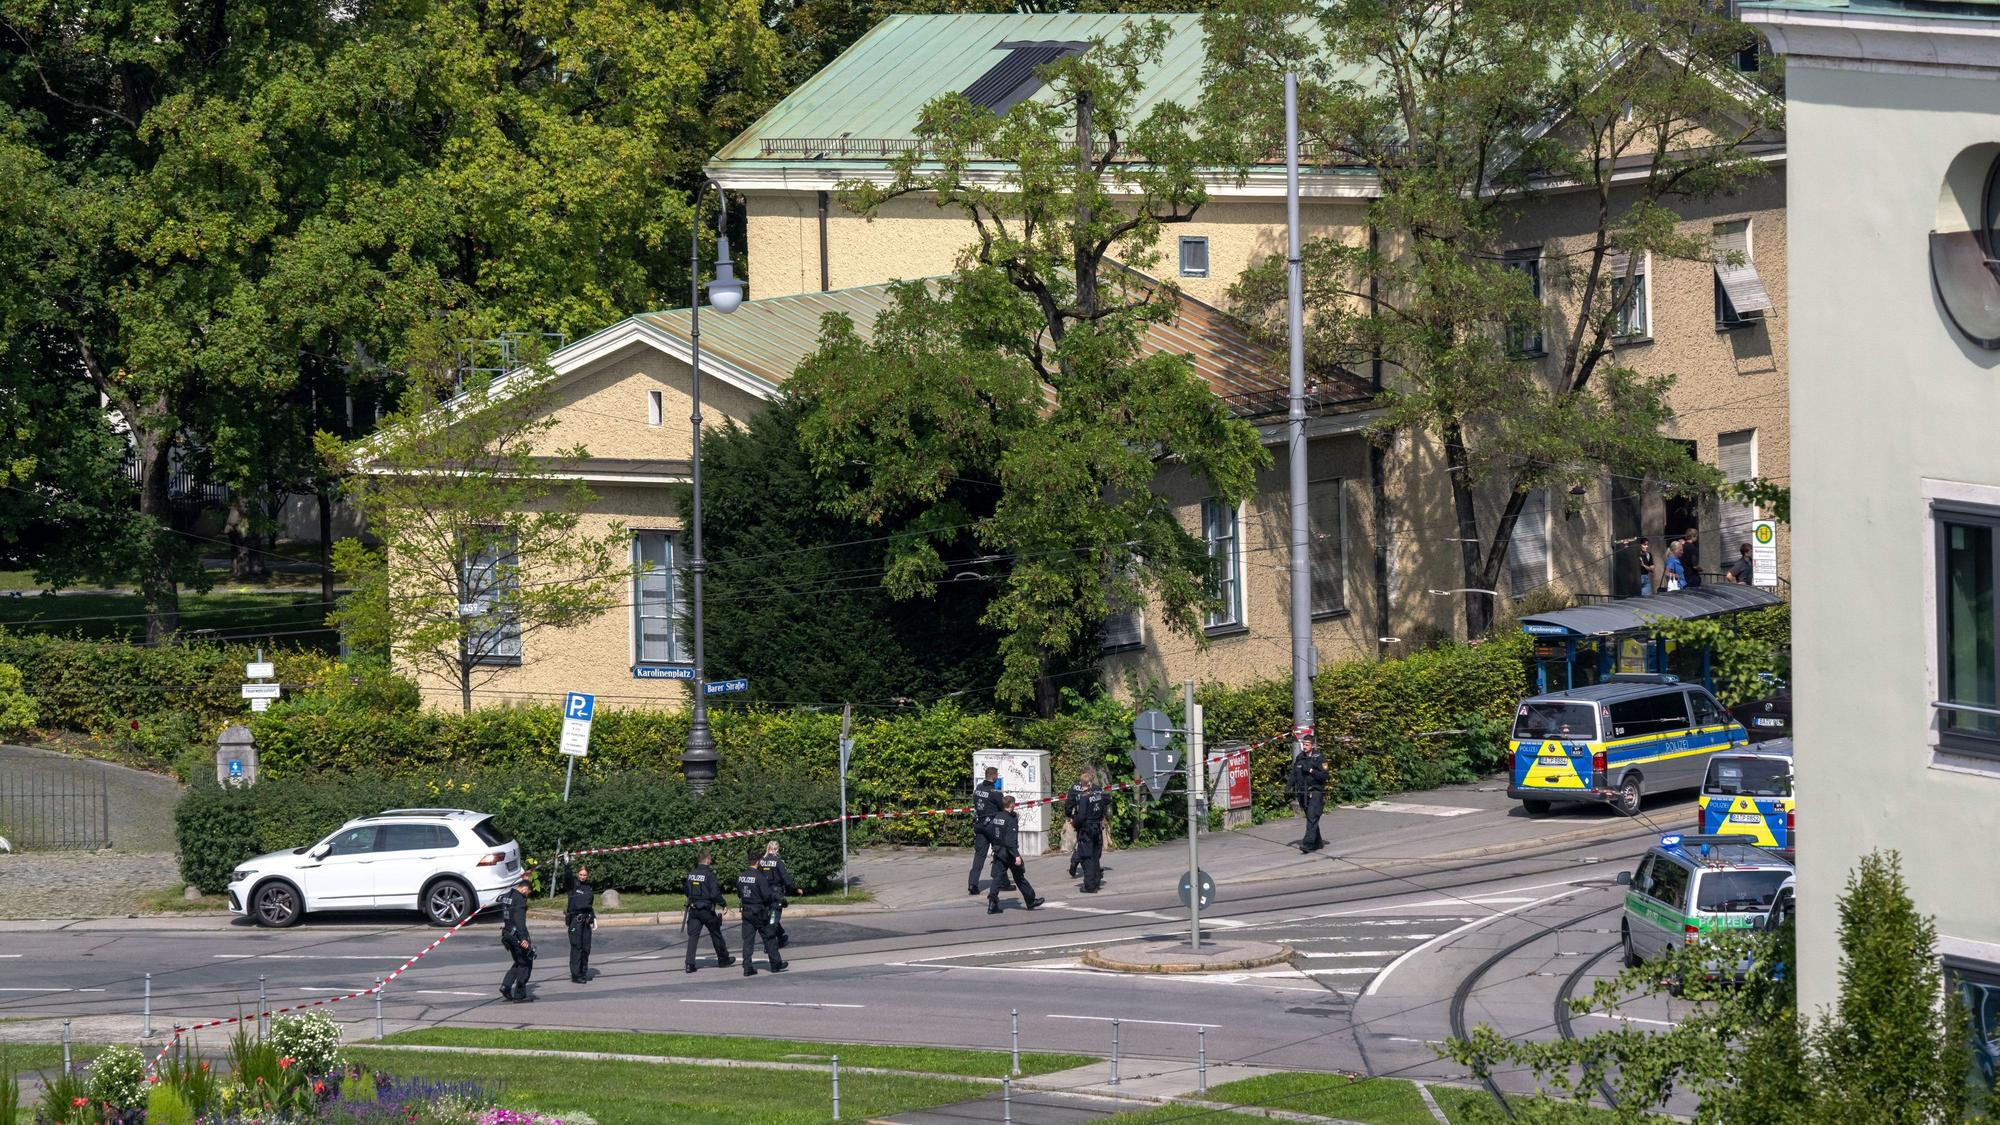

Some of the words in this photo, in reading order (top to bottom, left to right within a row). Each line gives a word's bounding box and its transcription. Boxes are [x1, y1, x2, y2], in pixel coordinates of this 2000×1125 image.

[637, 668, 691, 679] Karolinenplatz
[707, 684, 724, 693] Barer
[726, 681, 745, 691] Straße
[570, 695, 586, 716] P
[1519, 745, 1538, 753] POLIZEI
[1665, 739, 1689, 752] POLIZEI
[1230, 766, 1249, 779] offen
[1709, 801, 1729, 809] POLIZEI
[688, 874, 706, 882] POLIZEI
[739, 876, 756, 884] POLIZEI
[1699, 916, 1743, 928] POLIZEI
